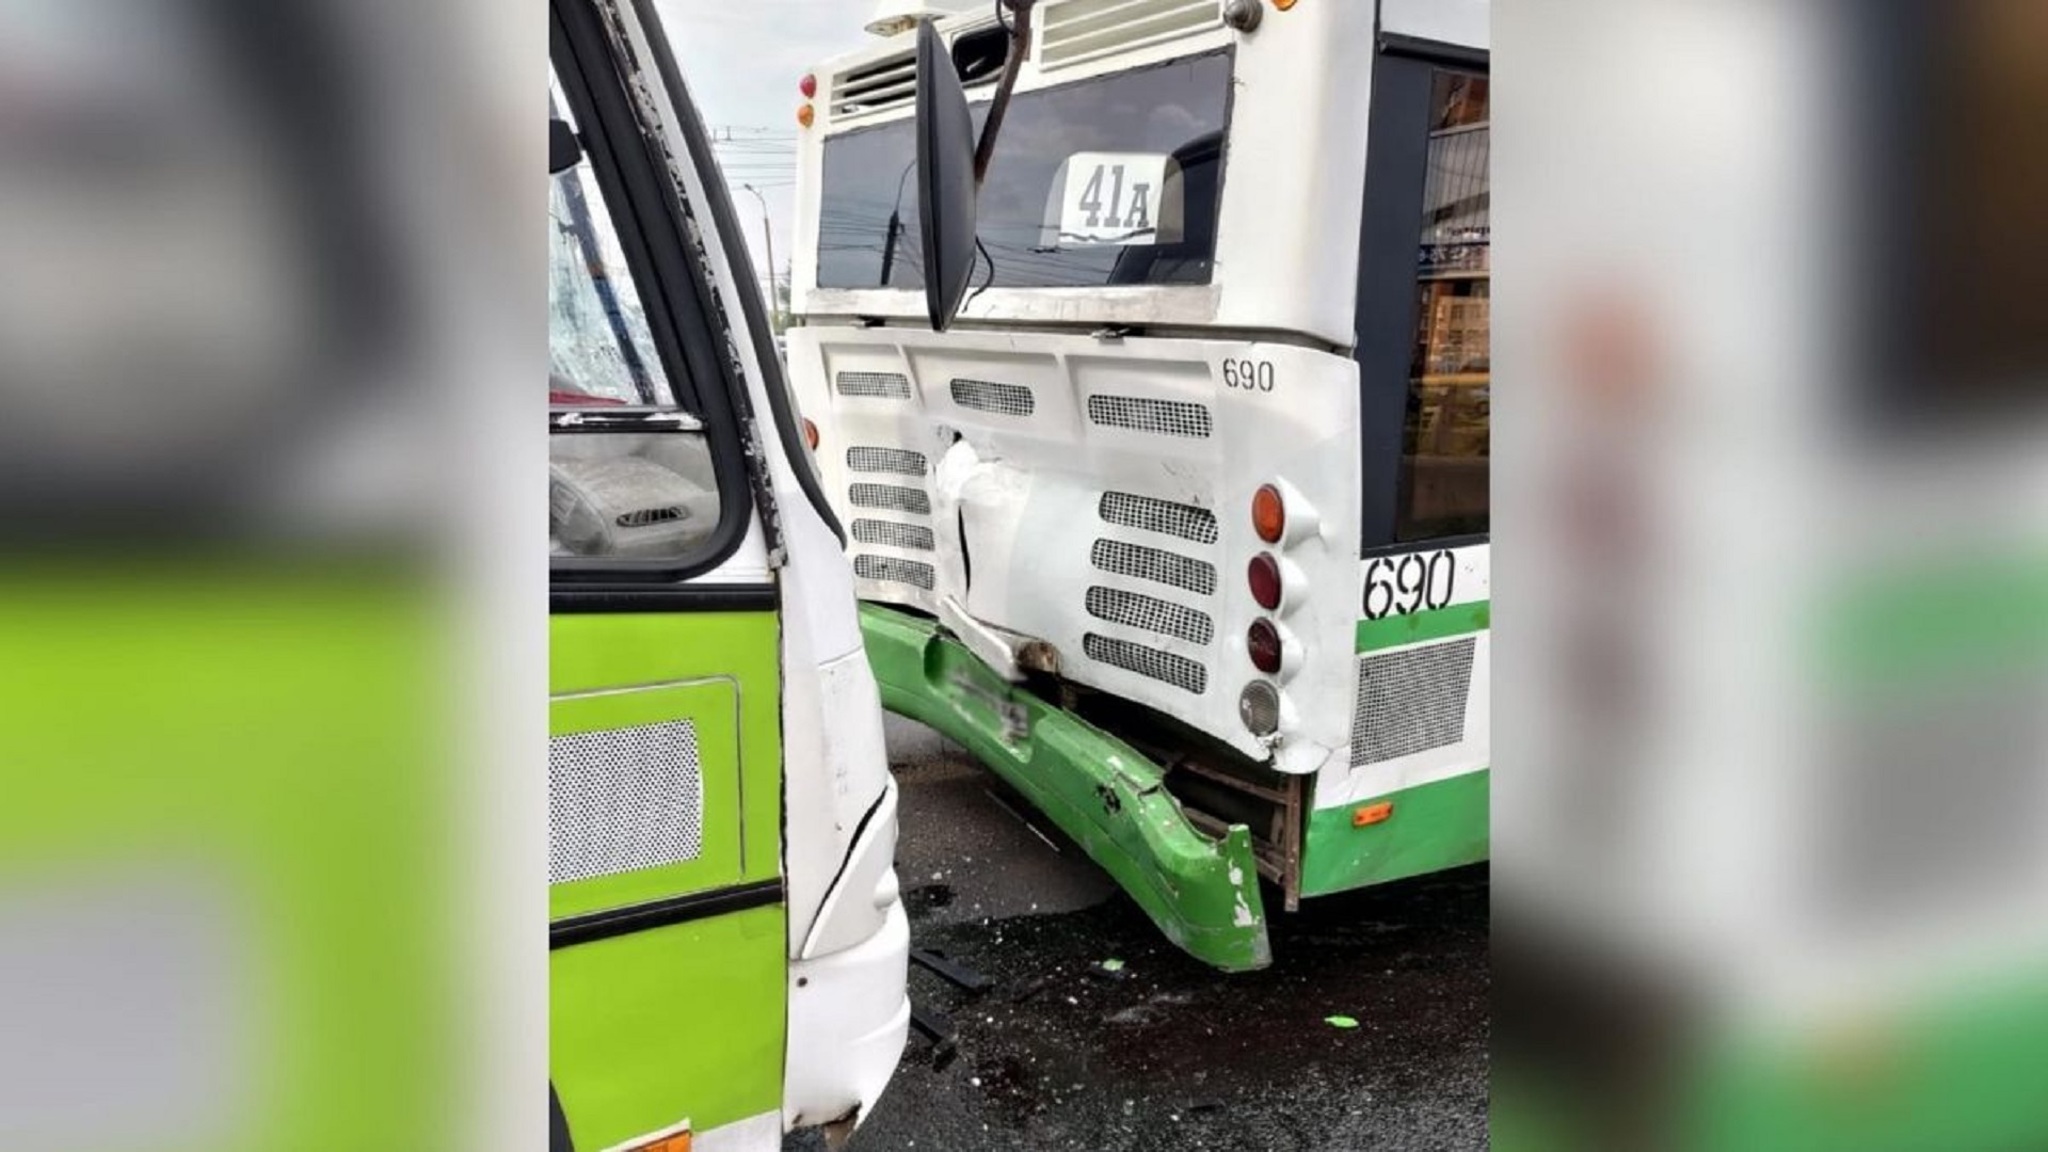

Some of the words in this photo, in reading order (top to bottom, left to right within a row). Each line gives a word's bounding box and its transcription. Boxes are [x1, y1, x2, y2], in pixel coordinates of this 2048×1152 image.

[1079, 164, 1150, 227] 41A
[1223, 358, 1274, 392] 690
[1363, 549, 1455, 621] 690
